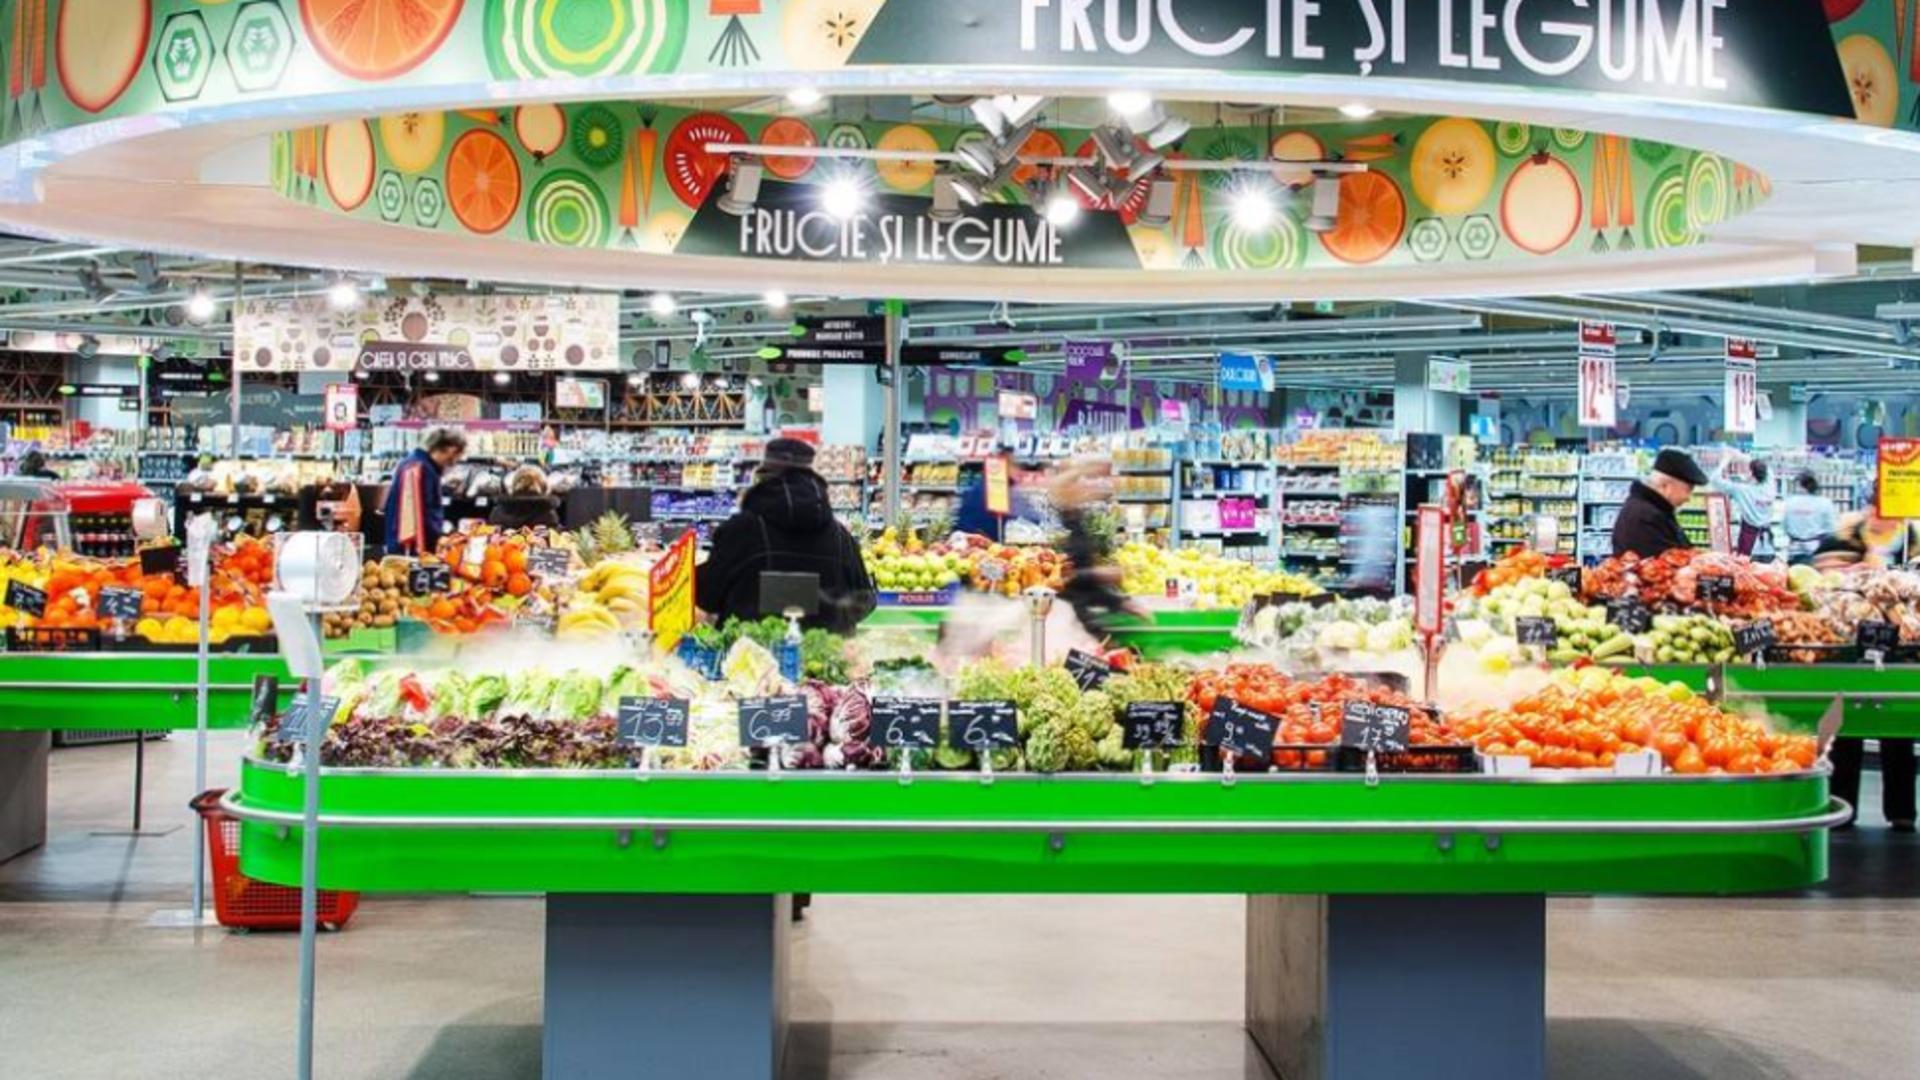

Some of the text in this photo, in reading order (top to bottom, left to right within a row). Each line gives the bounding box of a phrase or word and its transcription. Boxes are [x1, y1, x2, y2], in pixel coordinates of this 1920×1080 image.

[1438, 0, 1728, 90] LEGUME
[917, 216, 1063, 264] LEGUME
[886, 715, 906, 744] 6
[964, 714, 987, 744] 6
